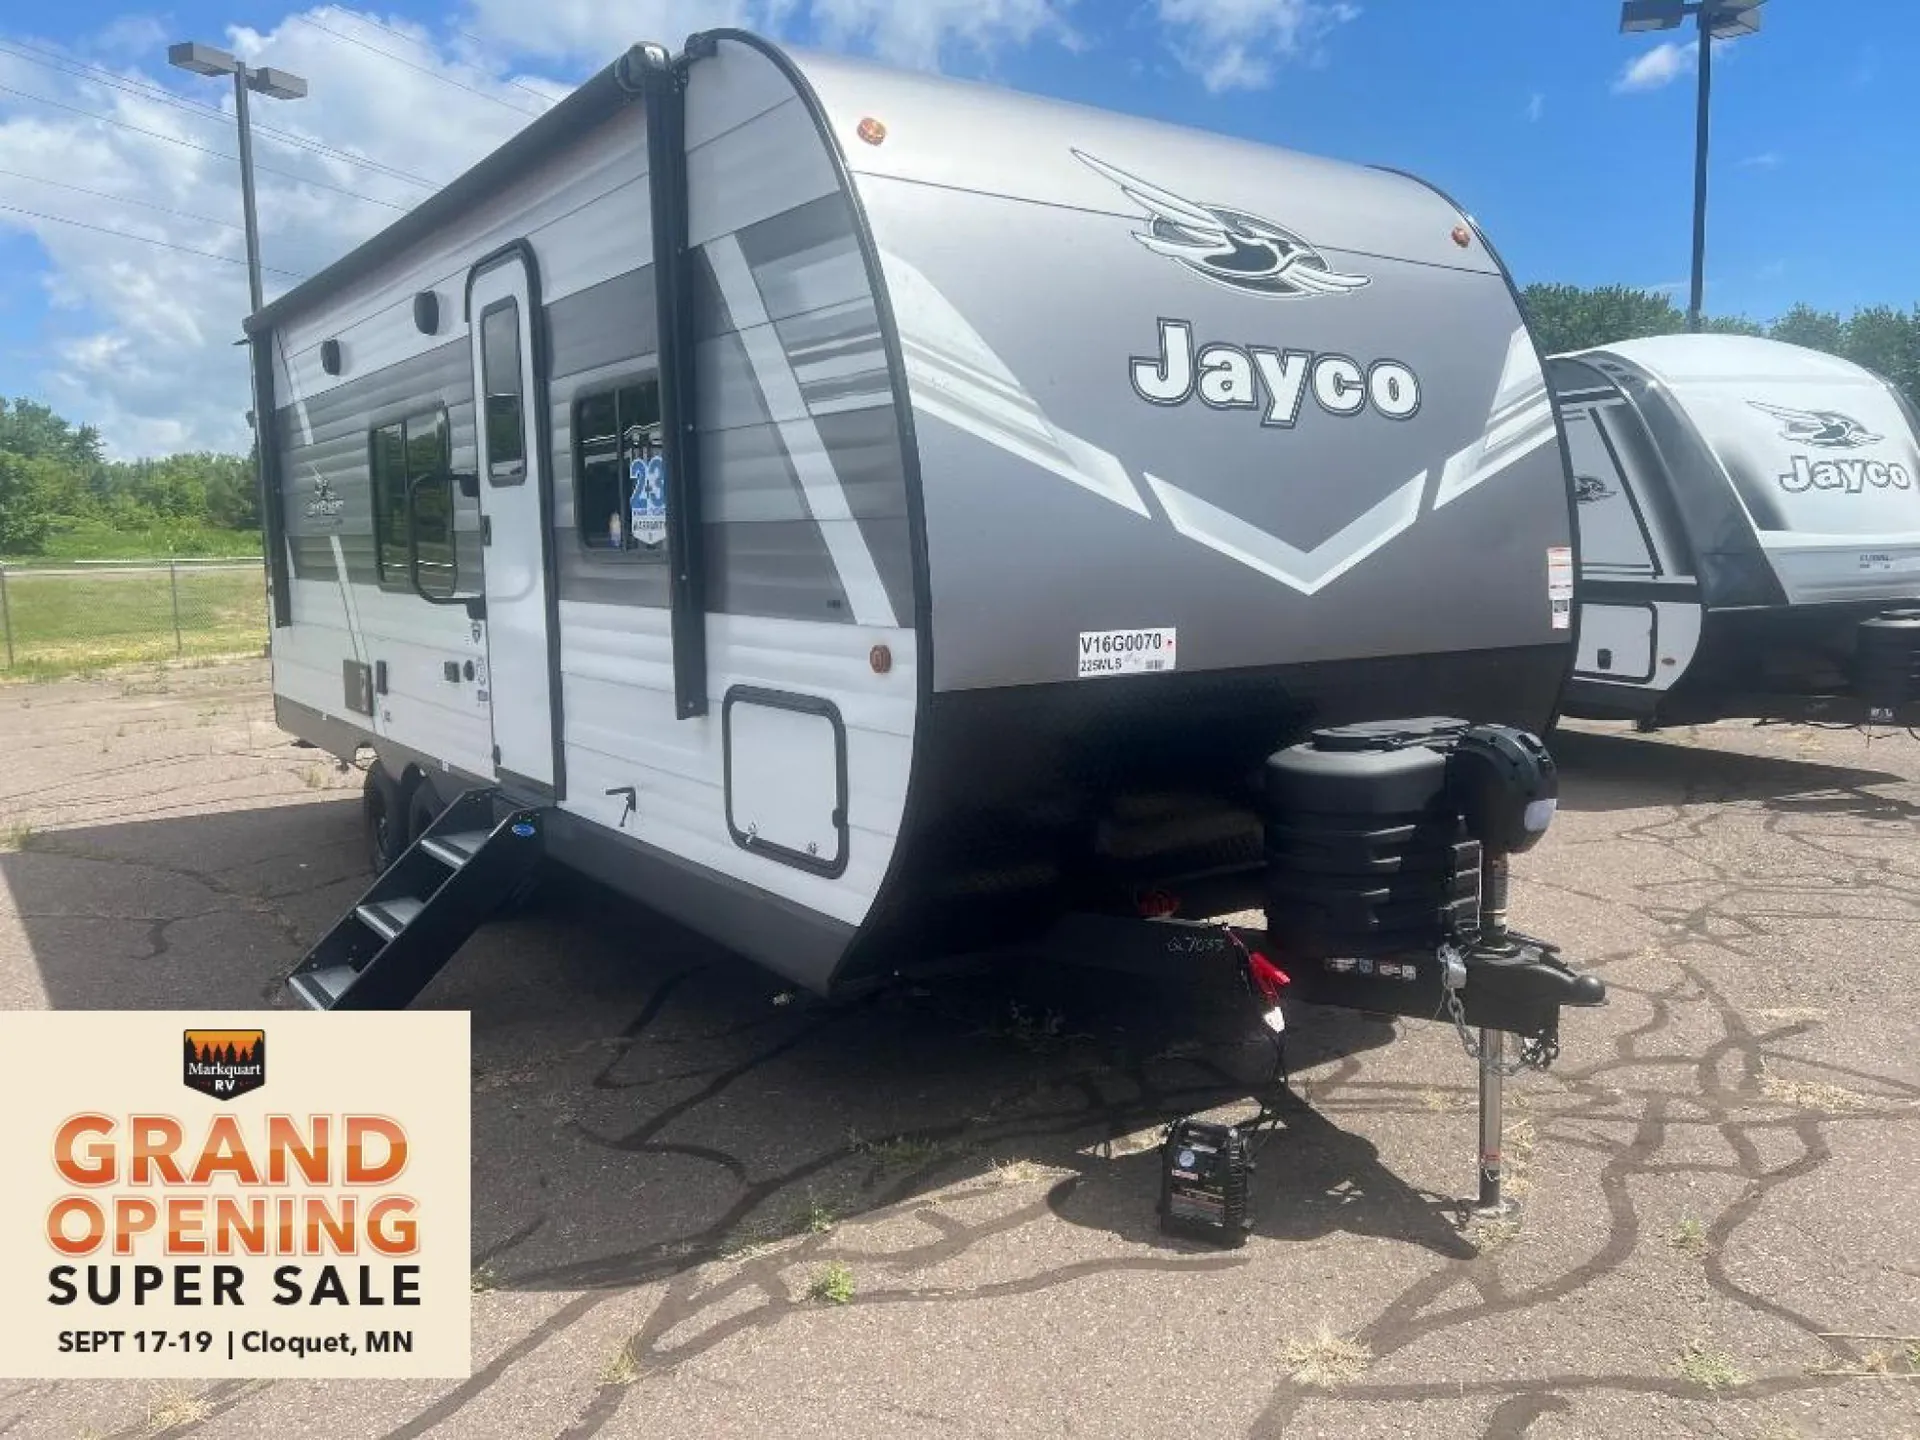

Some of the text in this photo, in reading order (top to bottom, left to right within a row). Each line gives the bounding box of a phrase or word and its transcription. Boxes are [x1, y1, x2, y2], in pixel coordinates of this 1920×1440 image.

[1128, 316, 1422, 429] Jayco
[1778, 455, 1911, 494] Jayco
[1081, 633, 1162, 654] V16G0070
